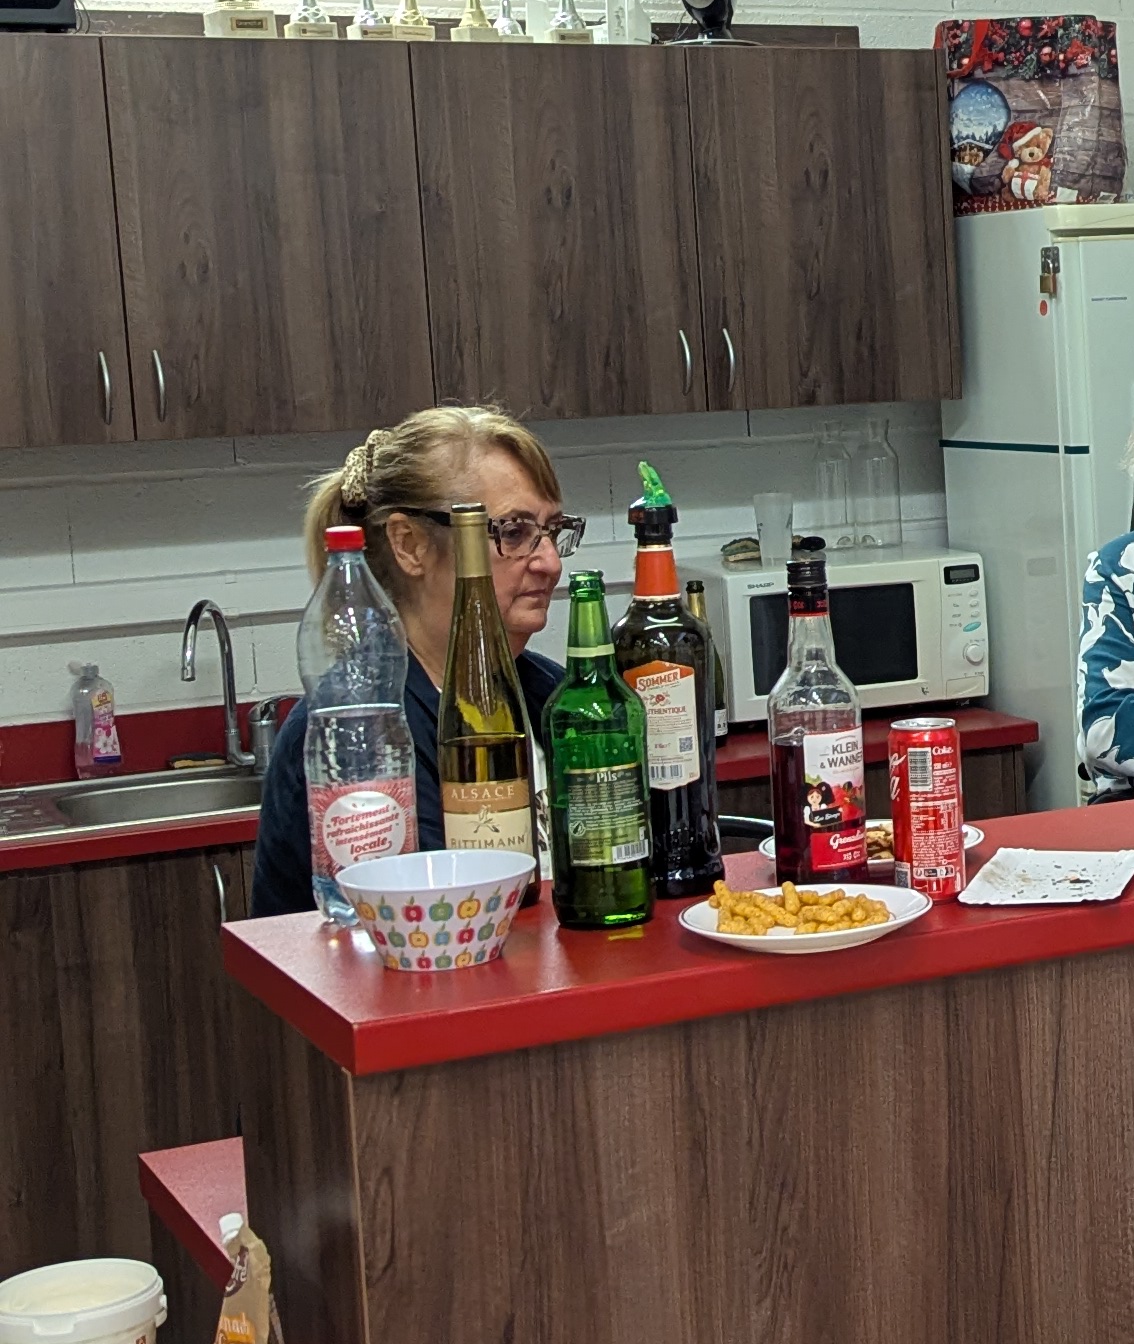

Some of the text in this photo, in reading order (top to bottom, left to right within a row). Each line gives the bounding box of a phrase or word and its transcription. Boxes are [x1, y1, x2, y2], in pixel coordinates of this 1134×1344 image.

[637, 671, 680, 692] SOMMER
[831, 740, 859, 755] KLEIN
[819, 761, 826, 770] &
[596, 770, 618, 783] Pils
[451, 785, 515, 800] ALSACE
[349, 836, 388, 855] locale
